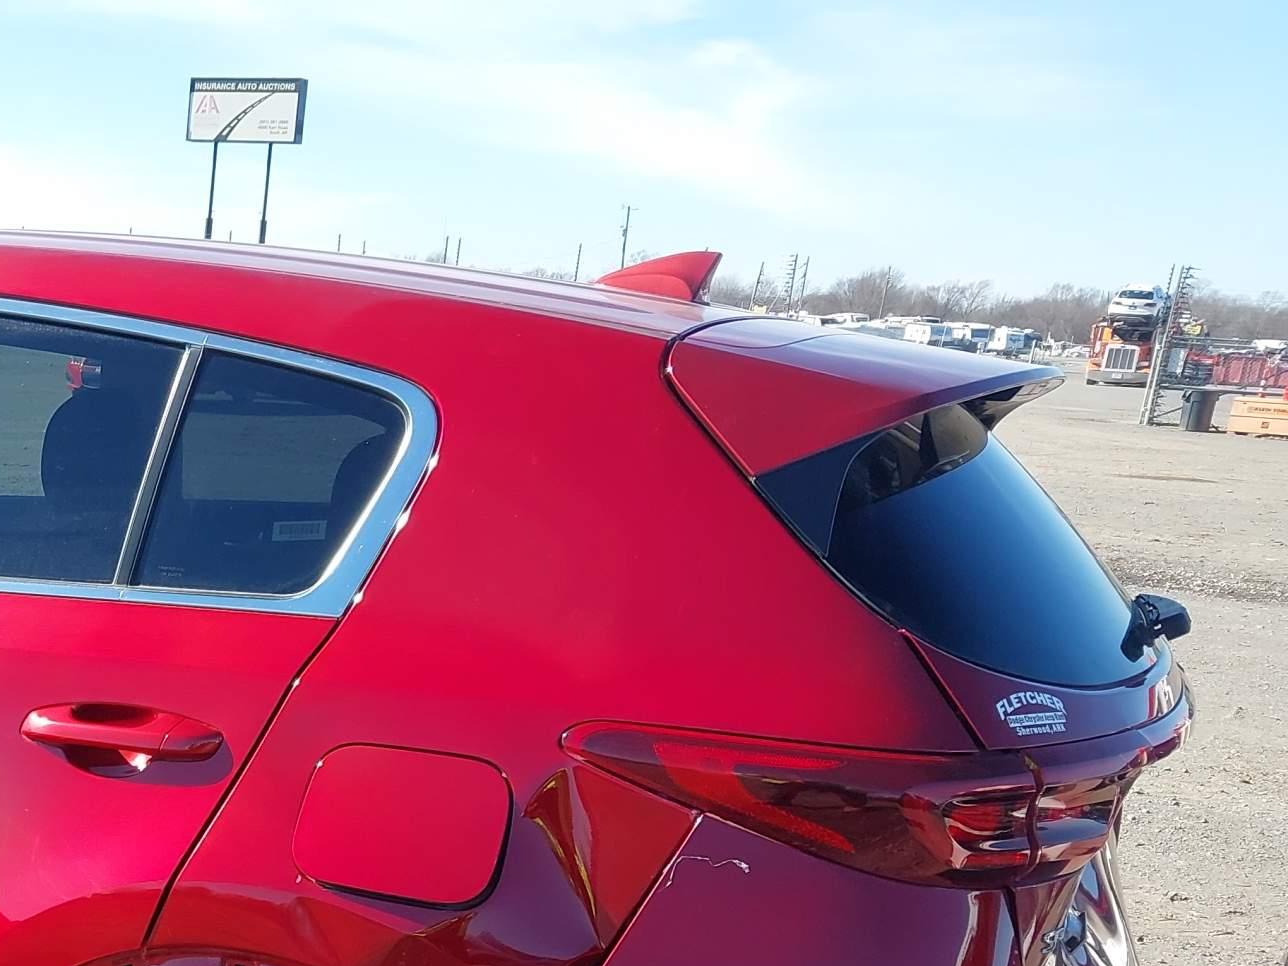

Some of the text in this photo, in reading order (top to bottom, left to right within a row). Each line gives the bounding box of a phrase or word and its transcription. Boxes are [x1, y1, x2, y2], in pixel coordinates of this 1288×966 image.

[195, 82, 296, 91] INSURANCE AUTO AUCTIONS
[996, 691, 1067, 720] FLETCHER
